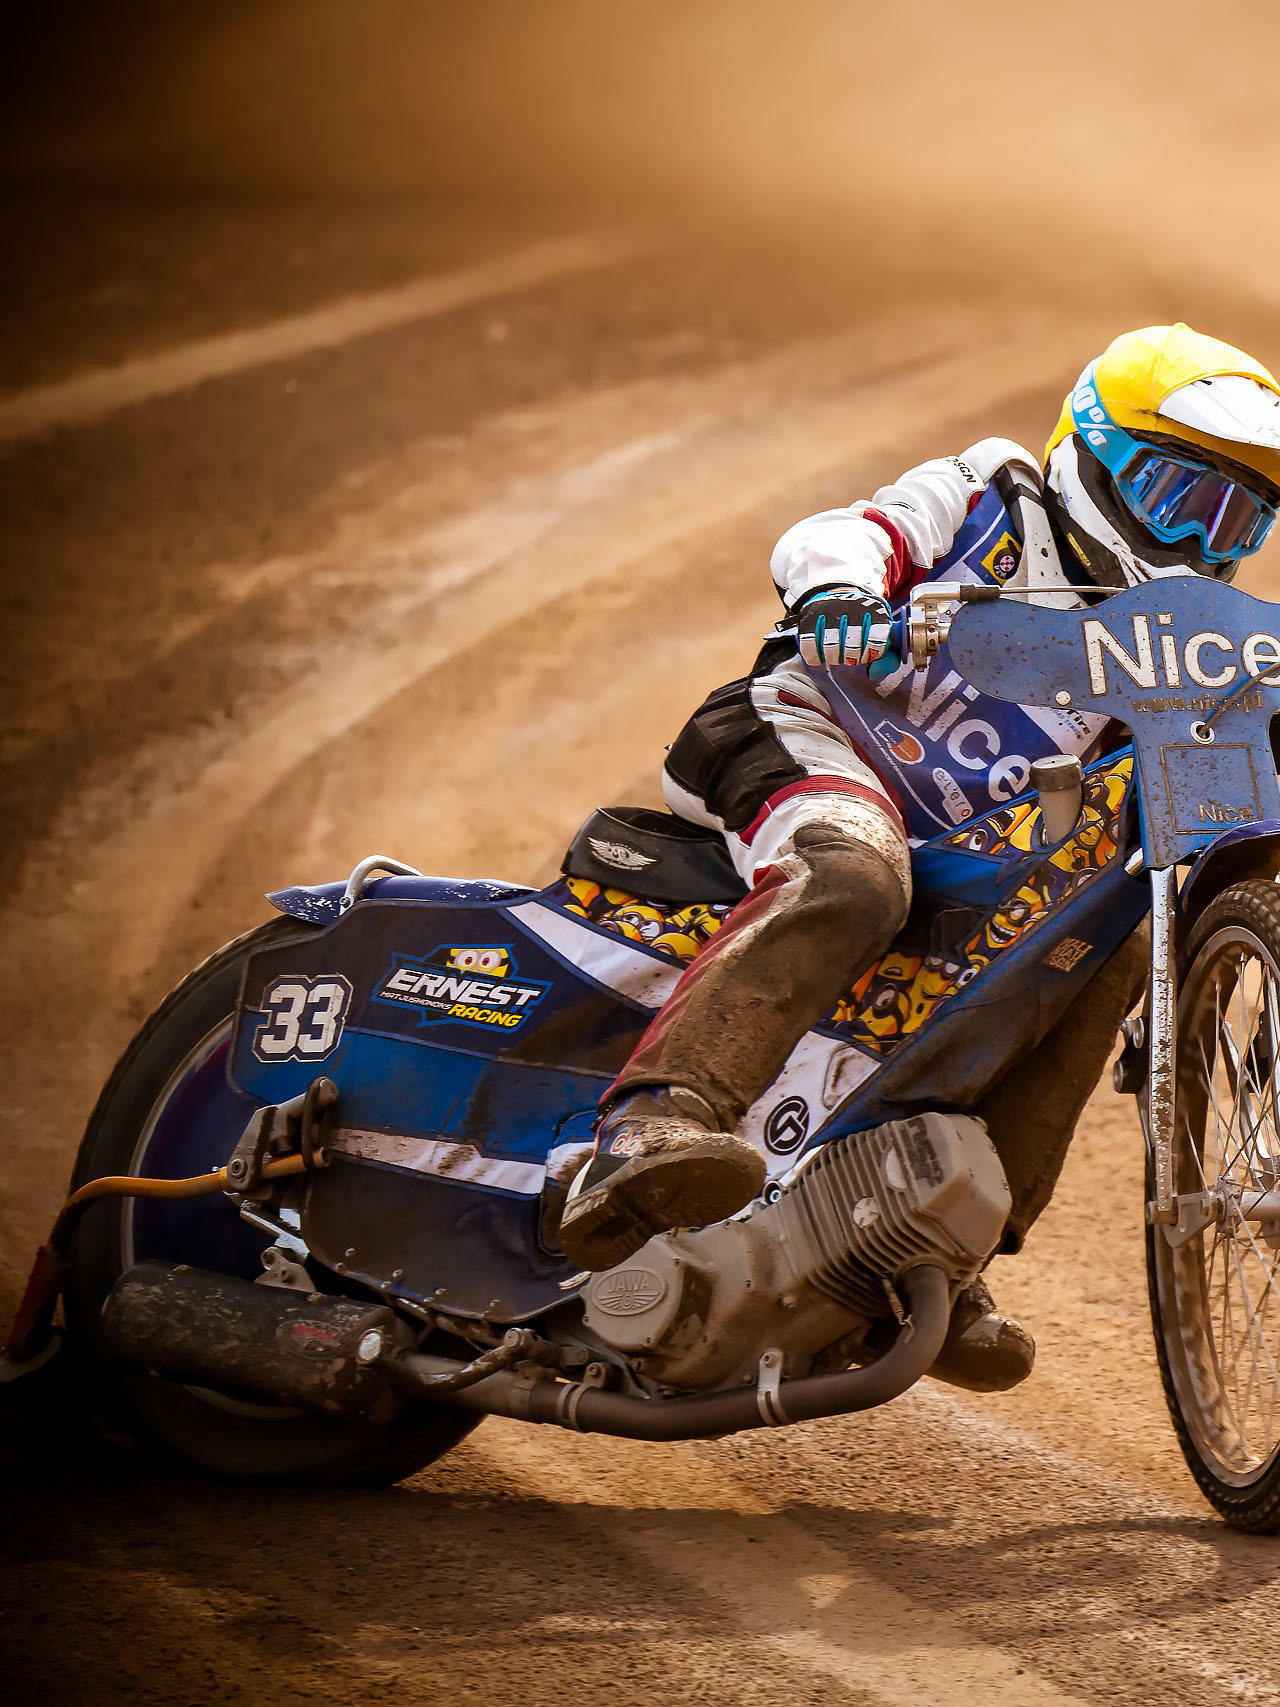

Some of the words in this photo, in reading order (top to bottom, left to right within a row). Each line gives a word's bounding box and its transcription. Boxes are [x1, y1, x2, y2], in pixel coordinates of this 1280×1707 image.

[875, 652, 1032, 802] Nice
[1198, 802, 1255, 824] Nice
[386, 968, 541, 1006] ERNEST
[256, 978, 349, 1057] 33
[448, 1004, 523, 1027] RACING
[608, 1274, 649, 1293] JAWA
